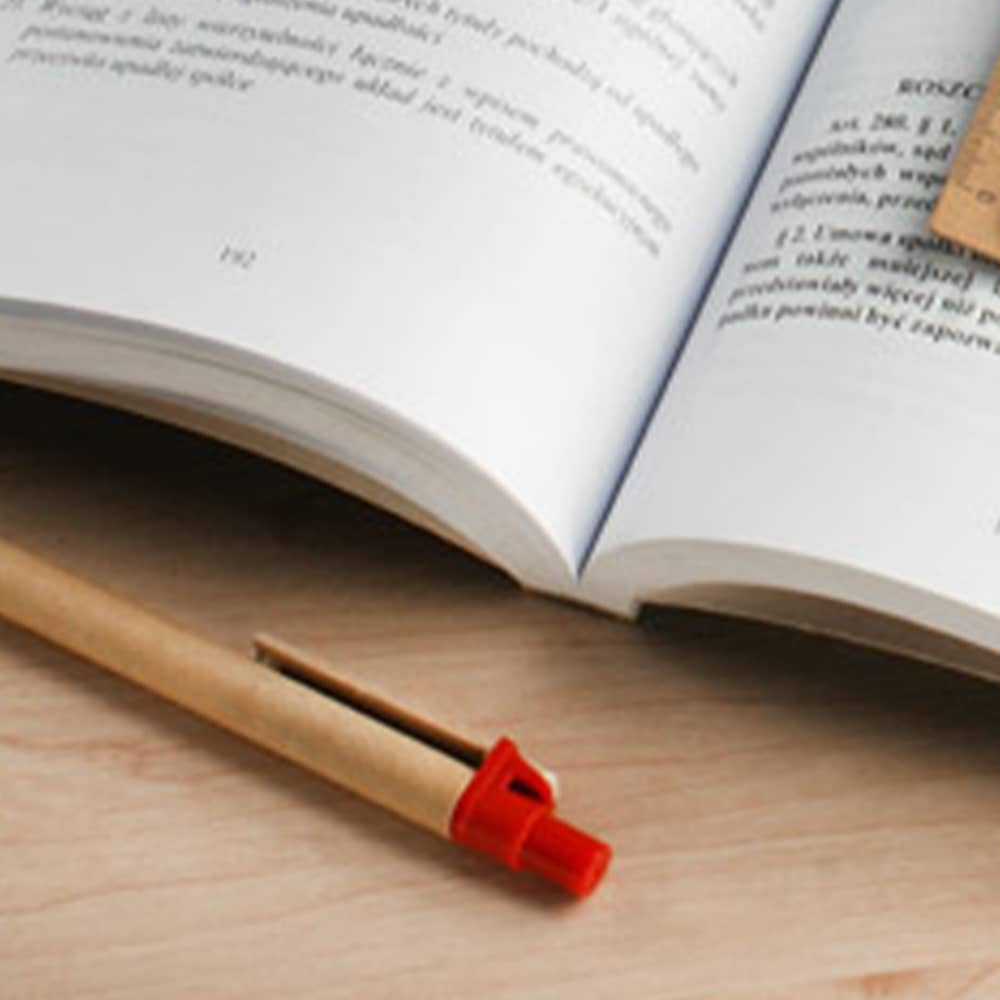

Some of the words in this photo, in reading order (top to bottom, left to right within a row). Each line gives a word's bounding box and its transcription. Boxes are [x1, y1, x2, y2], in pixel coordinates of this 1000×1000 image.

[796, 248, 850, 268] także
[867, 256, 976, 291] mniejszej
[865, 280, 936, 313] więcej
[940, 295, 976, 316] niż
[773, 303, 862, 326] powinni
[865, 308, 904, 333] być
